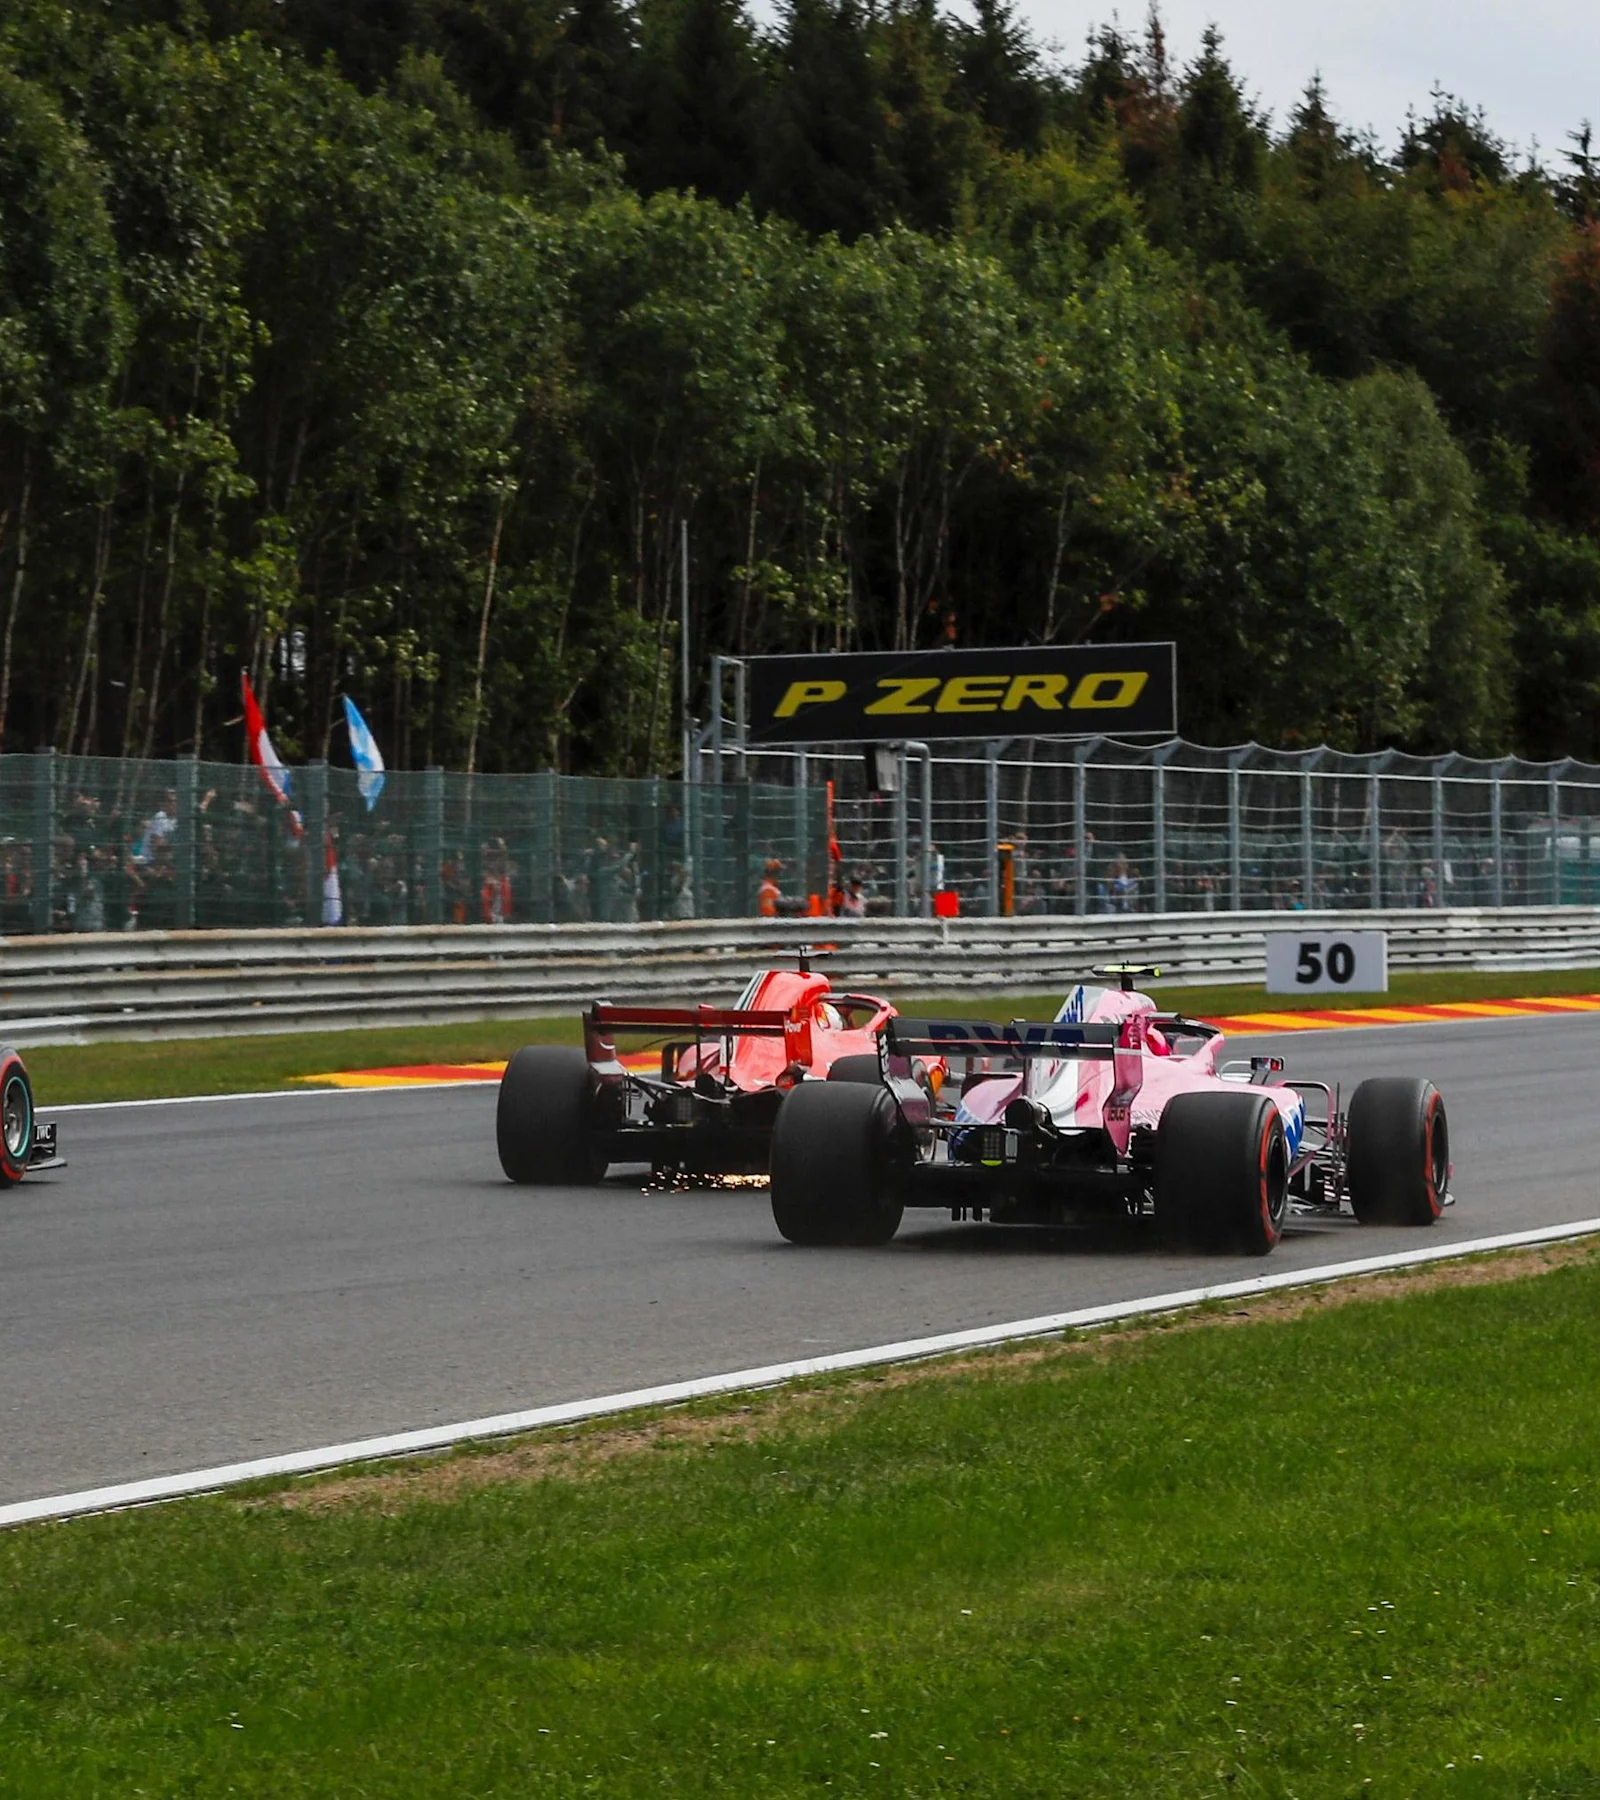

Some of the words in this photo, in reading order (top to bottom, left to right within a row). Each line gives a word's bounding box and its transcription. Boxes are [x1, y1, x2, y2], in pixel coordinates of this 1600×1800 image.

[773, 680, 847, 718] P
[863, 671, 1149, 714] ZERO
[1296, 942, 1356, 984] 50
[36, 1125, 51, 1140] IWC
